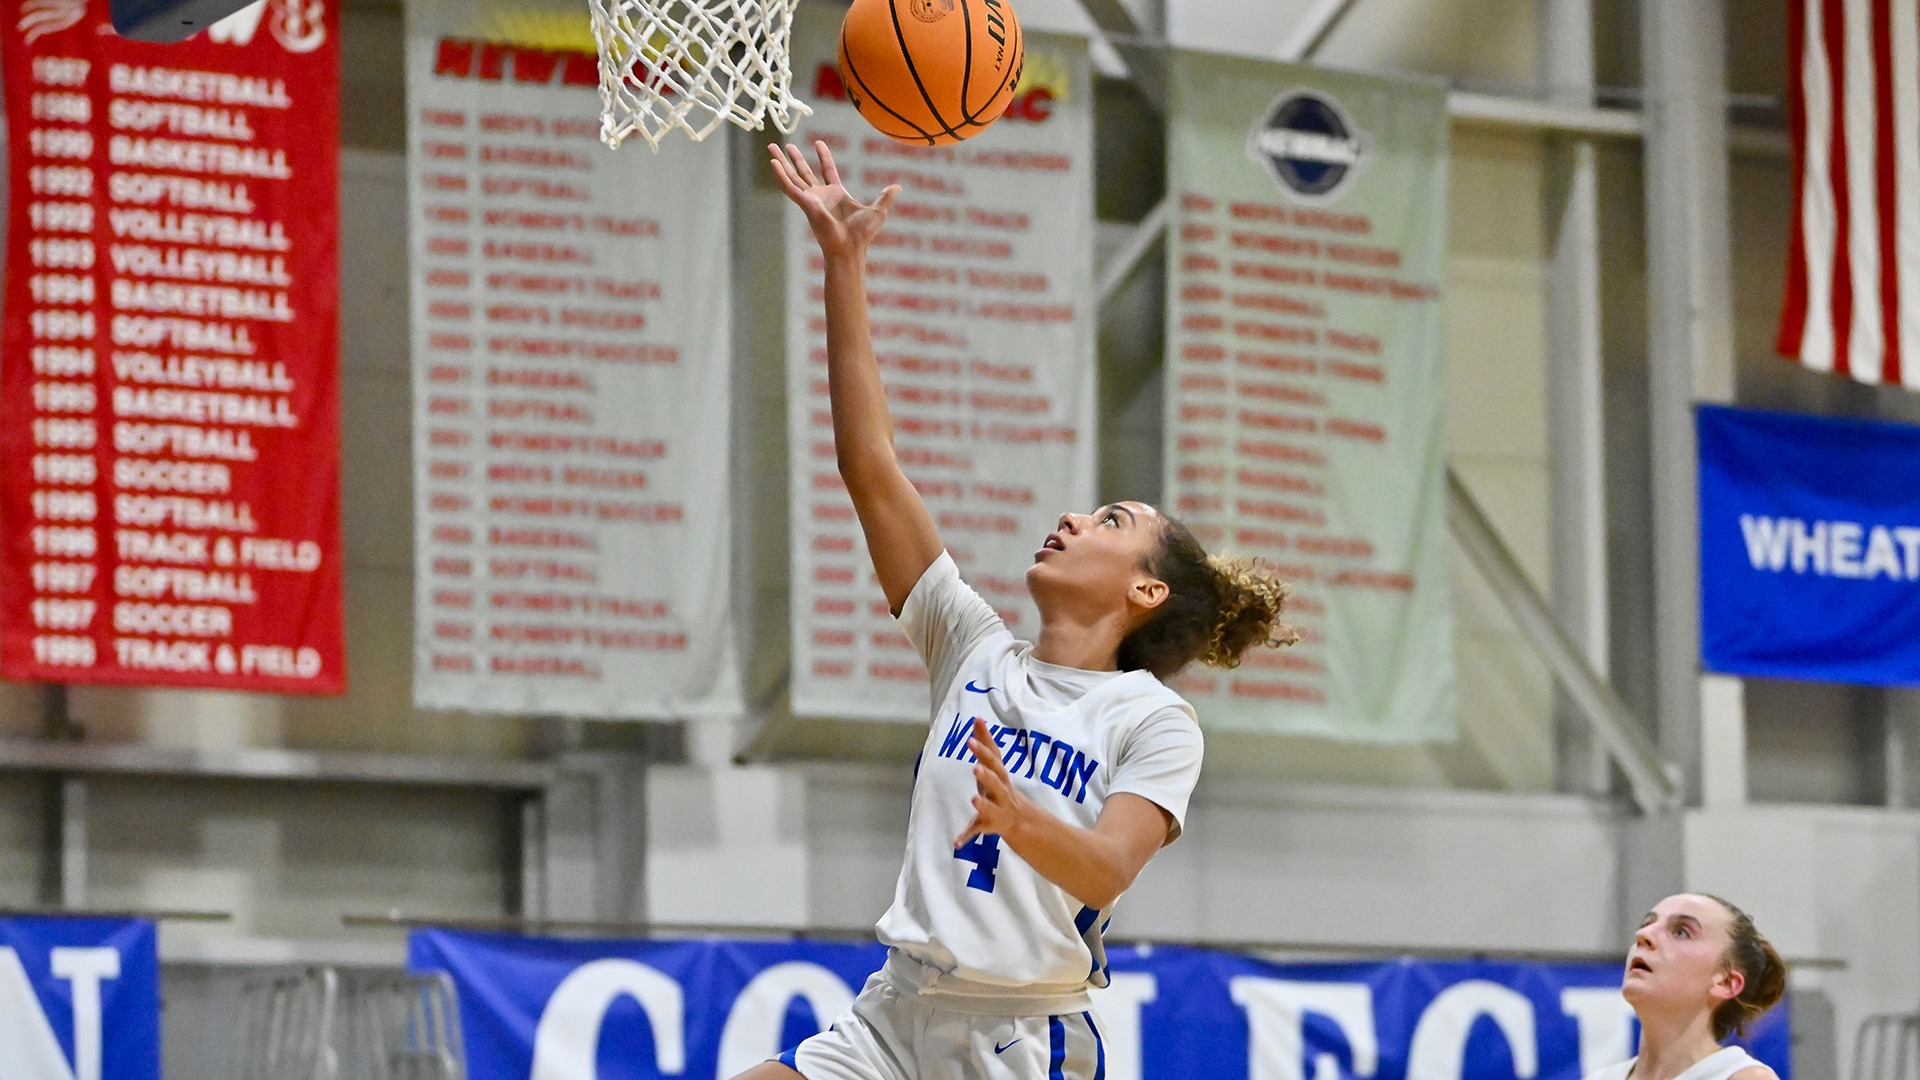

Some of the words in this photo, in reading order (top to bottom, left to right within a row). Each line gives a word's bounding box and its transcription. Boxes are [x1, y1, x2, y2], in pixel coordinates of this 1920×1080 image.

[993, 45, 1004, 73] NXT
[109, 64, 291, 108] BASKETBALL
[109, 98, 254, 140] SOFTBALL
[109, 135, 291, 179] BASKETBALL
[109, 172, 254, 213] SOFTBALL
[109, 208, 291, 250] VOLLEYBALL
[110, 244, 291, 286] VOLLEYBALL
[30, 274, 95, 304] 1994
[111, 278, 293, 321] BASKETBALL
[31, 310, 95, 340] 1994
[111, 314, 255, 354] SOFTBALL
[31, 346, 95, 376] 1994
[111, 351, 294, 392] VOLLEYBALL
[112, 385, 297, 427] BASKETBALL
[113, 421, 257, 461] SOFTBALL
[113, 457, 231, 493] SOCCER
[114, 493, 256, 532] SOFTBALL
[115, 529, 208, 563] TRACK
[213, 536, 235, 566] &
[241, 538, 321, 572] FIELD
[32, 562, 95, 593] 1997
[114, 565, 256, 604] SOFTBALL
[32, 598, 95, 629] 1997
[113, 601, 232, 636] SOCCER
[115, 637, 210, 671] TRACK
[215, 643, 236, 674] &
[241, 644, 321, 678] FIELD
[954, 831, 1000, 893] 4
